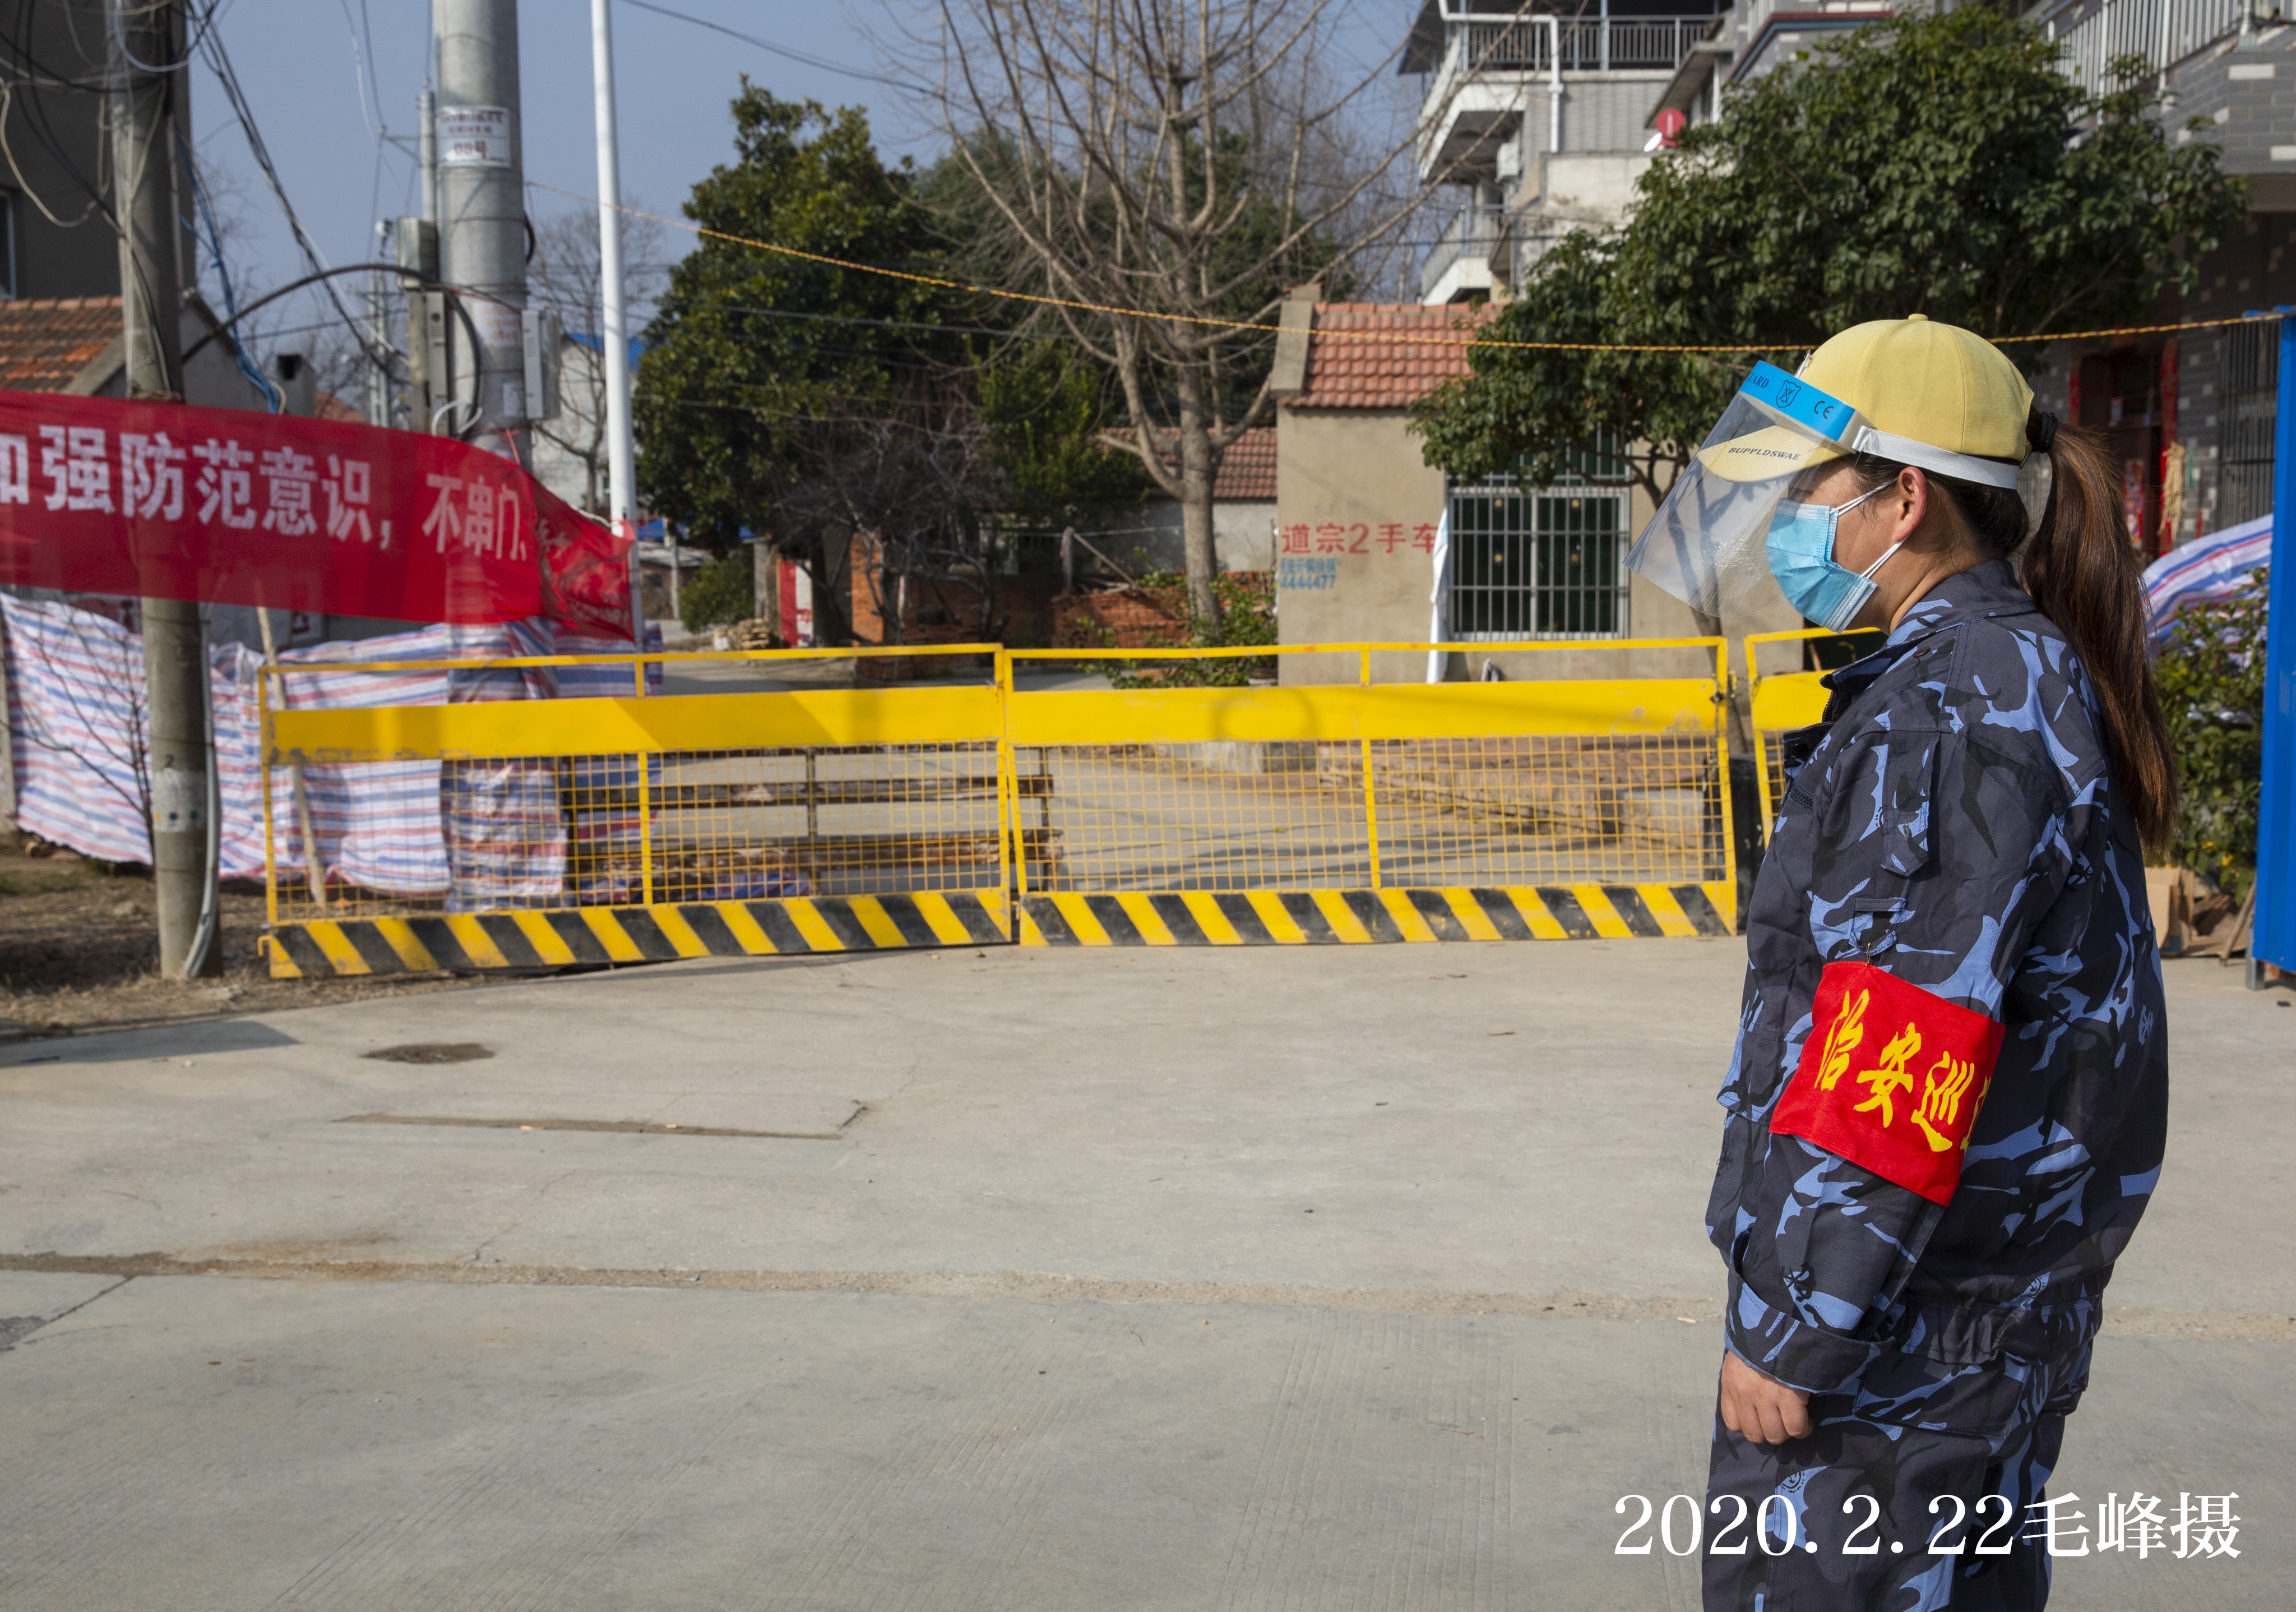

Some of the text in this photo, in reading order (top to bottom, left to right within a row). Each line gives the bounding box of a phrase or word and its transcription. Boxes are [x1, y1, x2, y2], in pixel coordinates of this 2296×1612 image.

[1747, 372, 1769, 388] UARD
[1814, 400, 1834, 419] CE
[1281, 522, 1439, 554] 道宗2手车
[1814, 989, 1991, 1154] 治安巡
